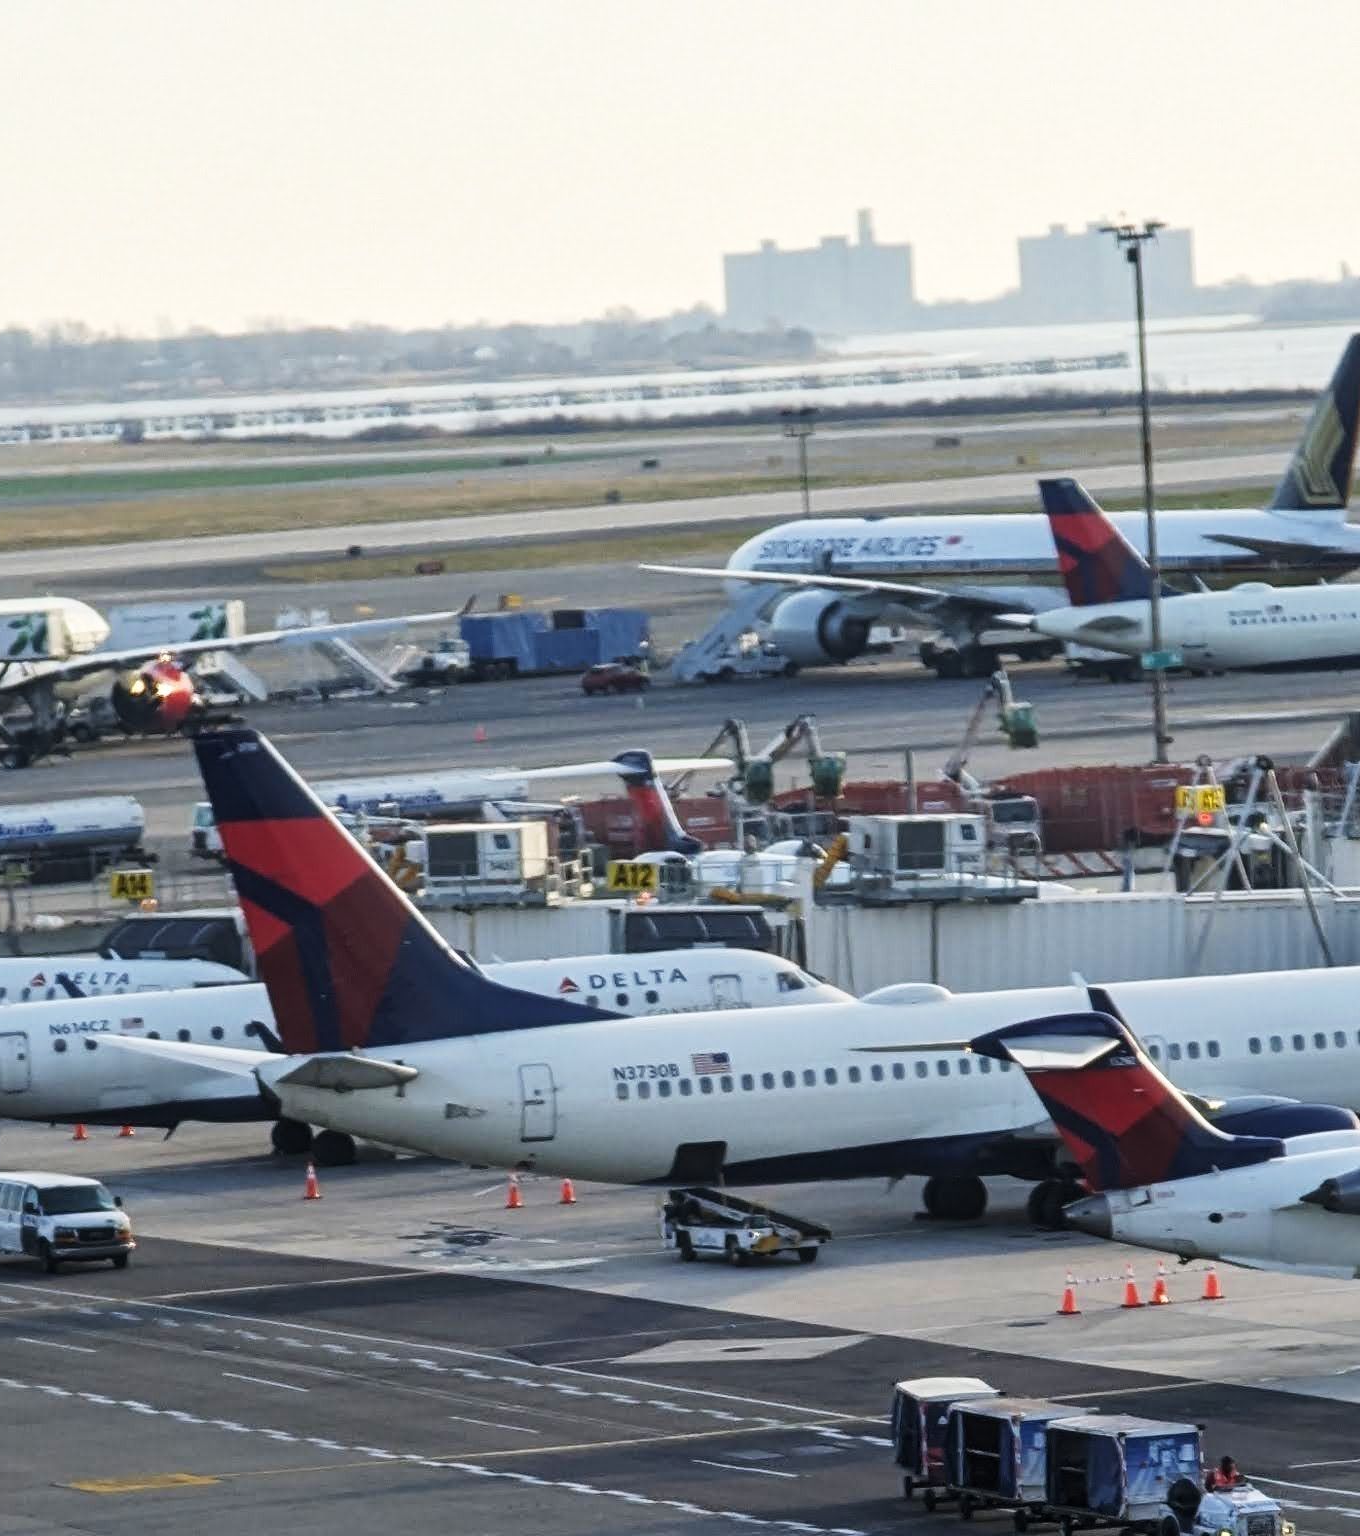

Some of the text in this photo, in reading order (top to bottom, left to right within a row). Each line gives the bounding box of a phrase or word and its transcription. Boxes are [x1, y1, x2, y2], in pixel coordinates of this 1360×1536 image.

[116, 872, 147, 895] A14
[613, 862, 652, 887] A12
[589, 967, 688, 989] DELTA
[613, 1063, 680, 1081] N3730B
